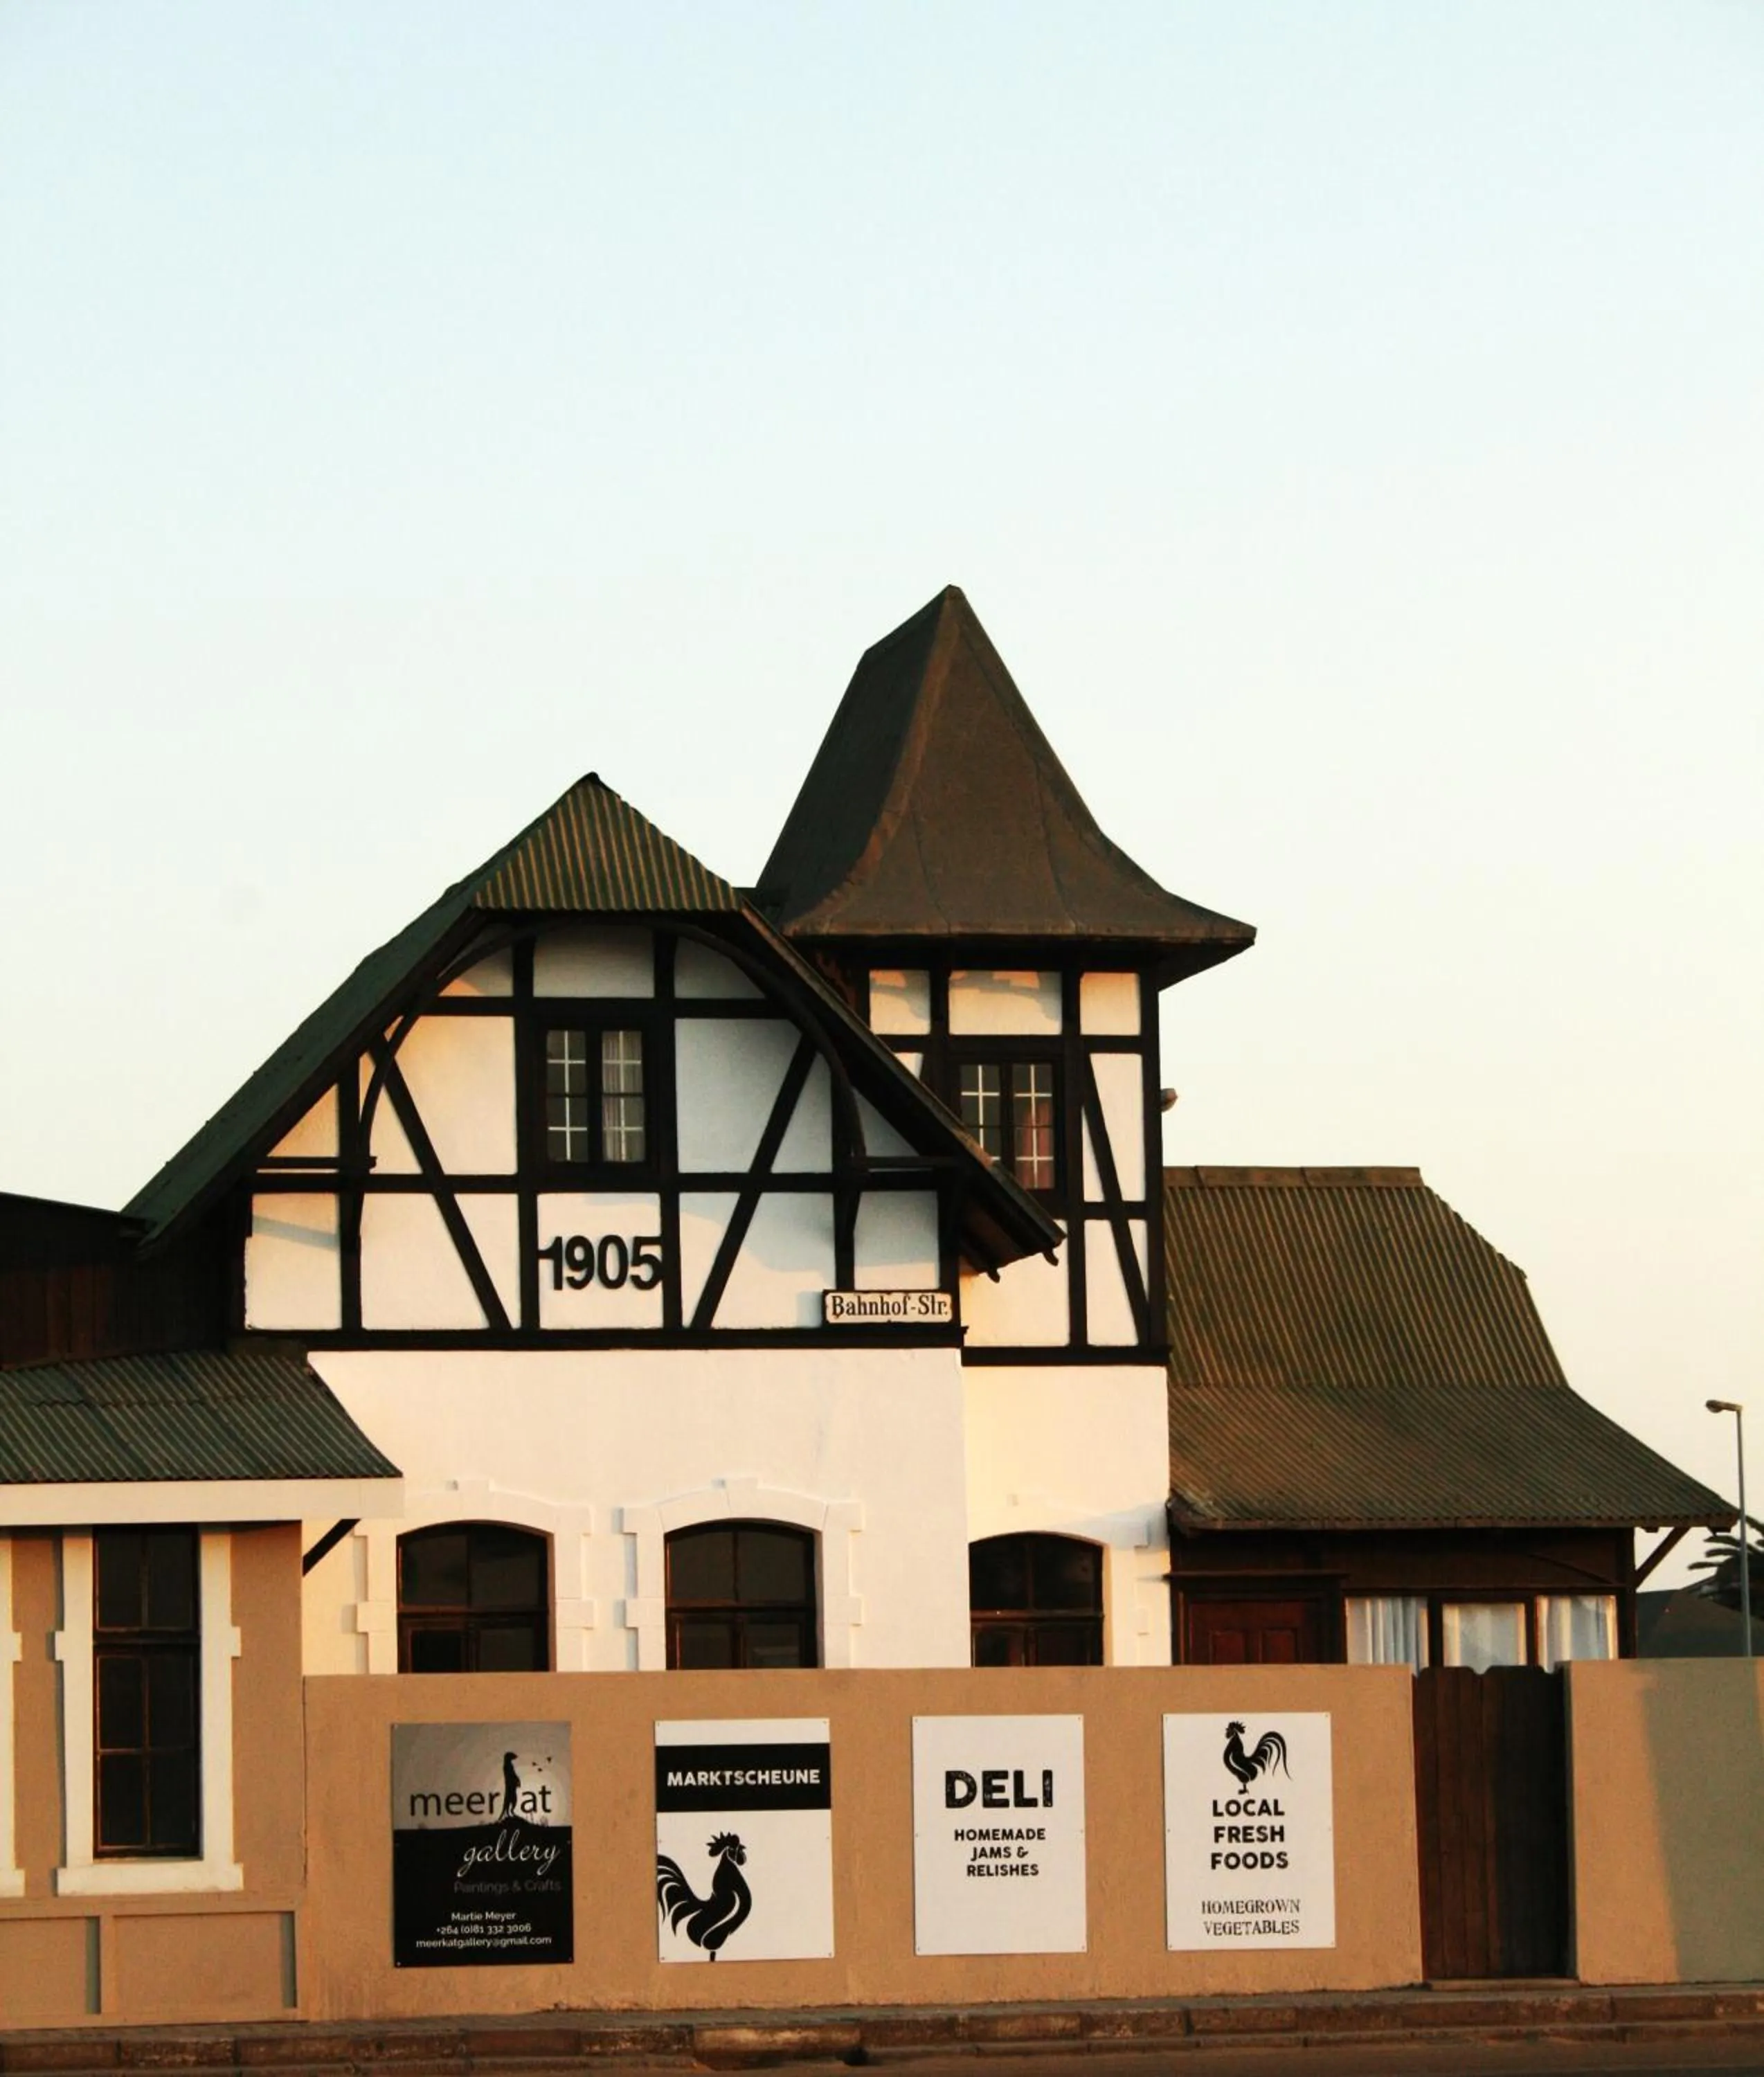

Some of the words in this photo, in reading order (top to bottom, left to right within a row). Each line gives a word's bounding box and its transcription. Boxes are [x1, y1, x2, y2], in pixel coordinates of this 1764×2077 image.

[537, 1234, 663, 1291] 1905
[831, 1294, 948, 1318] Bahnhof-Str.
[667, 1769, 820, 1787] MARKTSCHEUNE
[945, 1770, 1053, 1809] DELI
[1212, 1799, 1285, 1817] LOCAL
[954, 1828, 1046, 1842] HOMEMADE
[1214, 1825, 1285, 1844] FRESH
[456, 1828, 561, 1878] gallery
[971, 1846, 1011, 1862] JAMS
[1016, 1847, 1029, 1858] &
[1211, 1851, 1289, 1870] FOODS
[966, 1864, 1039, 1878] RELISHES
[512, 1880, 521, 1891] &
[524, 1878, 562, 1892] Crafts
[1201, 1899, 1300, 1915] HOMEGROWN
[487, 1924, 504, 1934] 332
[507, 1923, 531, 1933] 3006
[1203, 1920, 1300, 1936] VEGETABLES
